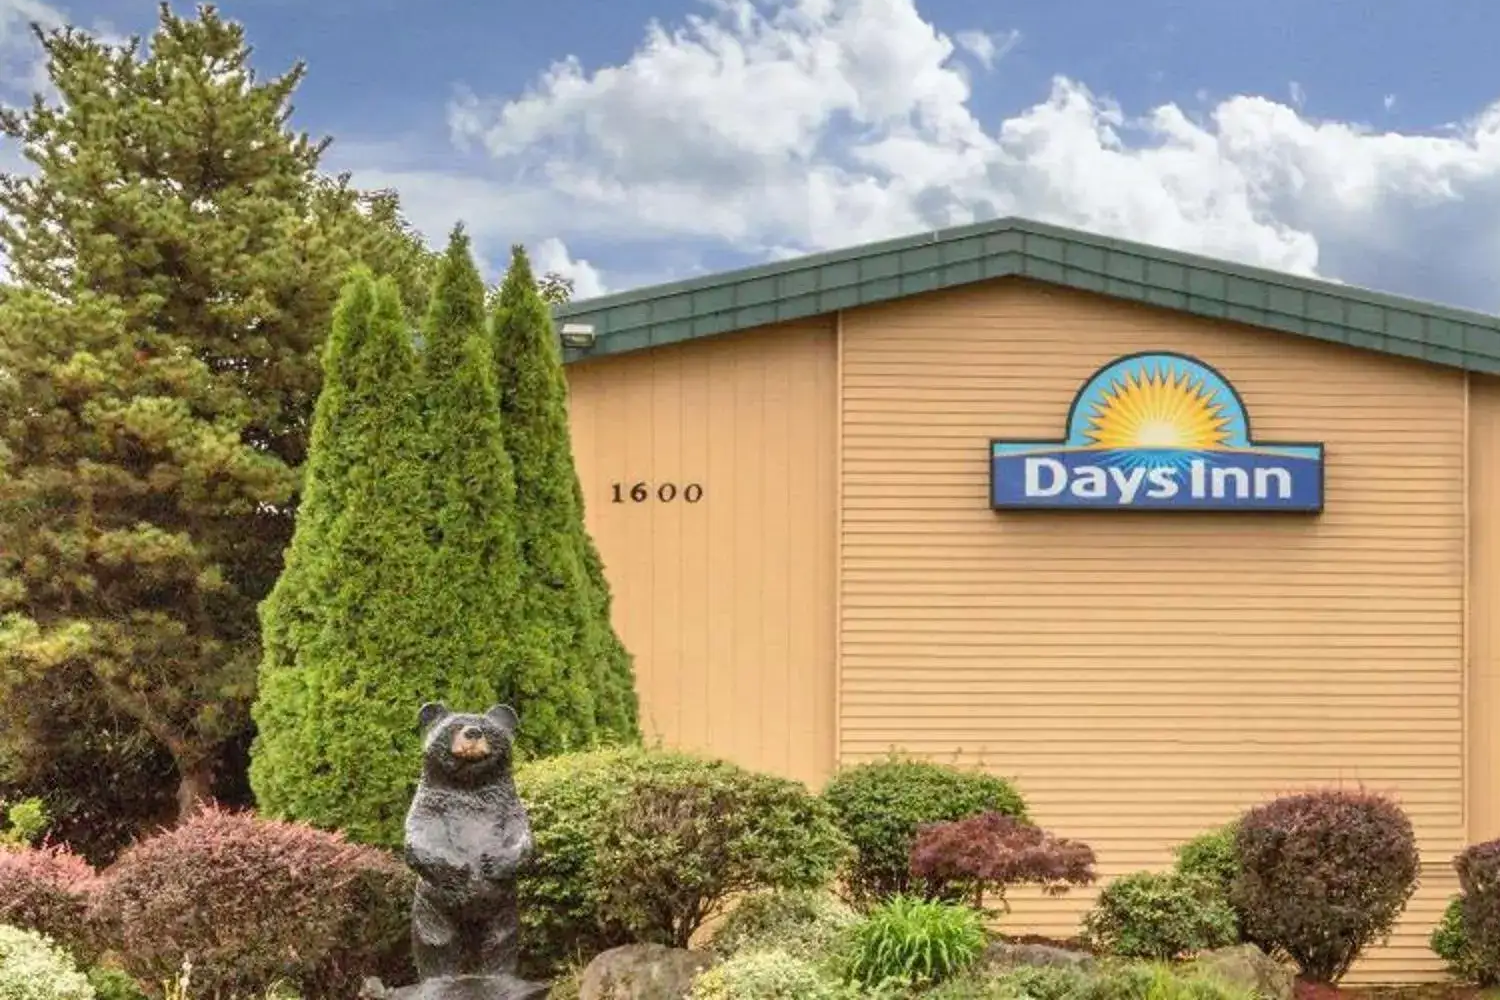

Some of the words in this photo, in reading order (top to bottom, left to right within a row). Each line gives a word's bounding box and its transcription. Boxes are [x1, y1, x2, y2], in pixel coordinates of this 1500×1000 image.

[611, 482, 703, 503] 1600
[1025, 458, 1178, 503] Days
[1191, 460, 1291, 499] Inn
